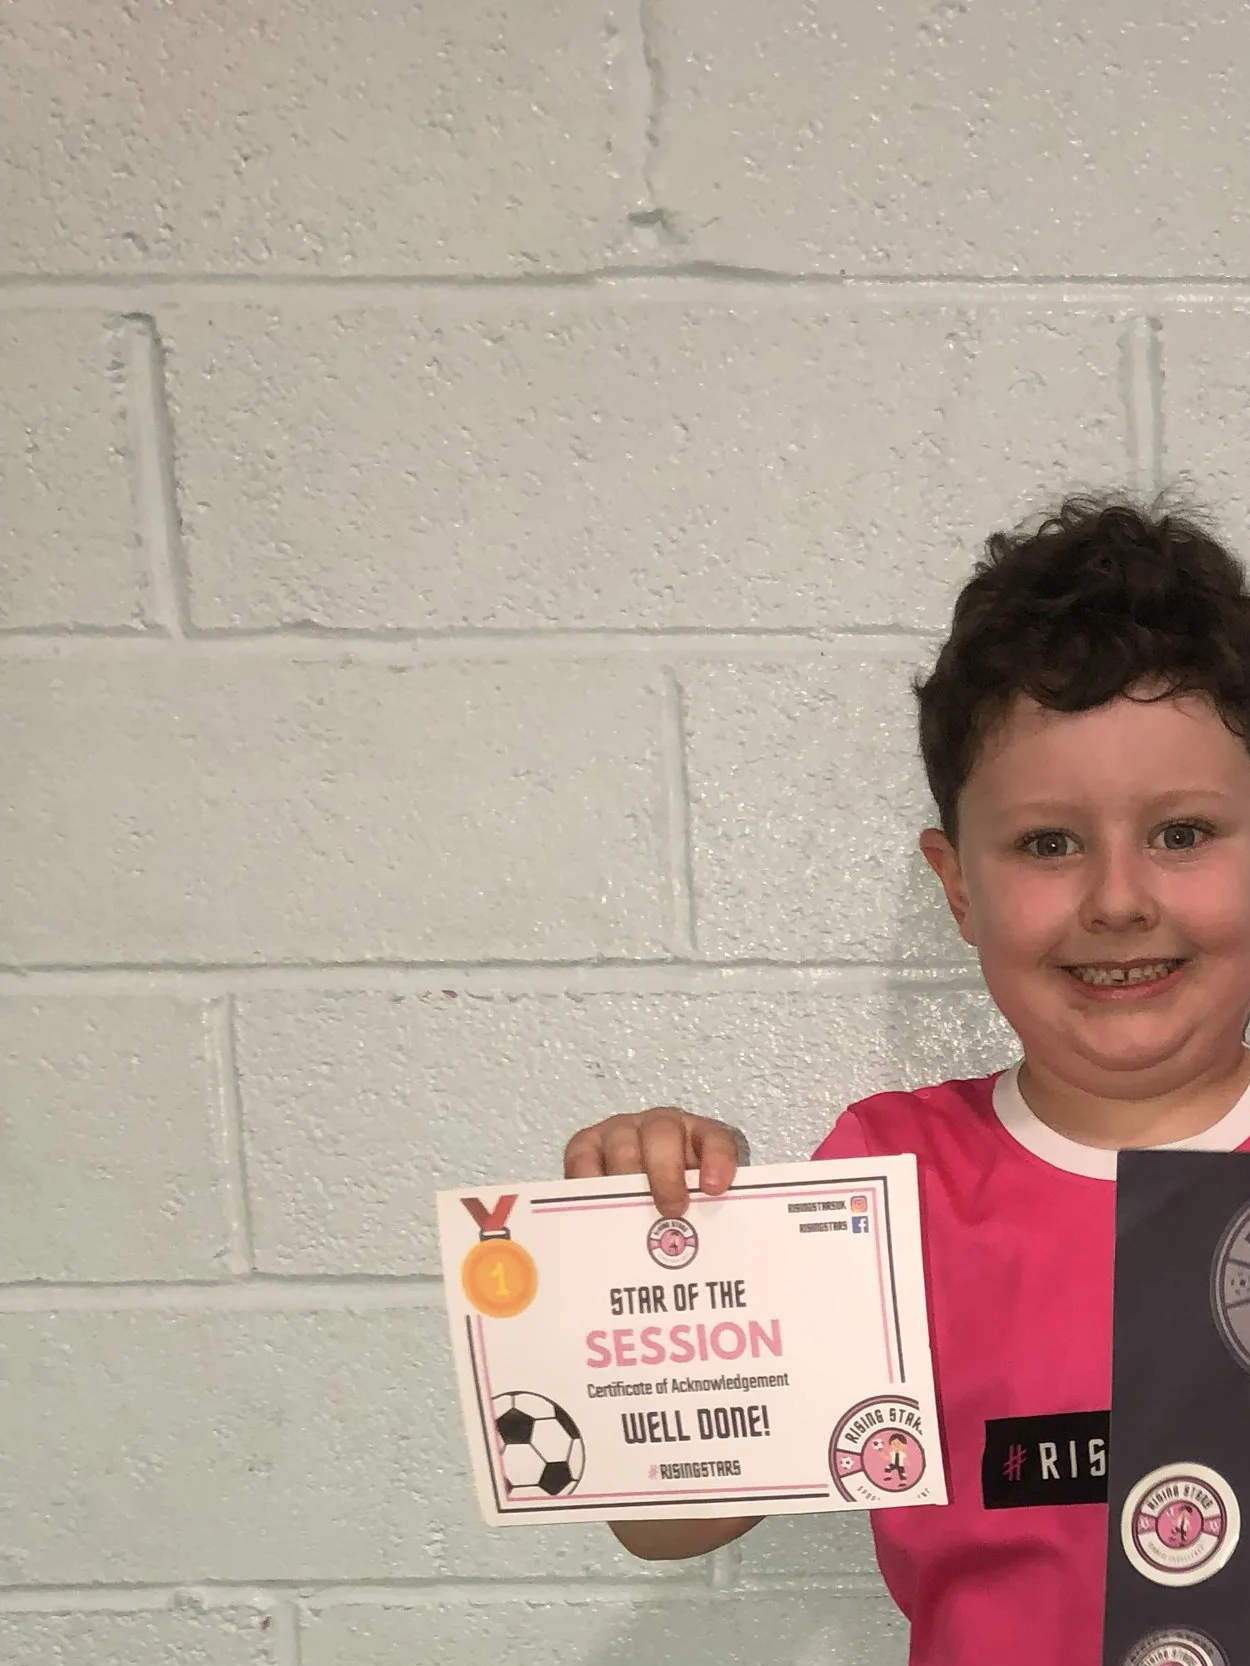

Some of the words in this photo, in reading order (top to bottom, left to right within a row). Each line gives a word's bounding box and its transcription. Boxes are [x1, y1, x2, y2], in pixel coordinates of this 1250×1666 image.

[610, 1285, 668, 1315] STAR
[673, 1283, 699, 1312] OF
[705, 1279, 747, 1309] THE
[585, 1319, 783, 1369] SESSION
[587, 1379, 653, 1399] Certificate
[655, 1378, 668, 1395] of
[671, 1372, 790, 1394] Acknowledgement
[621, 1410, 691, 1445] WELL
[696, 1405, 771, 1441] DONE!
[845, 1409, 884, 1444] RISING
[648, 1460, 741, 1481] #RISINGSTARS
